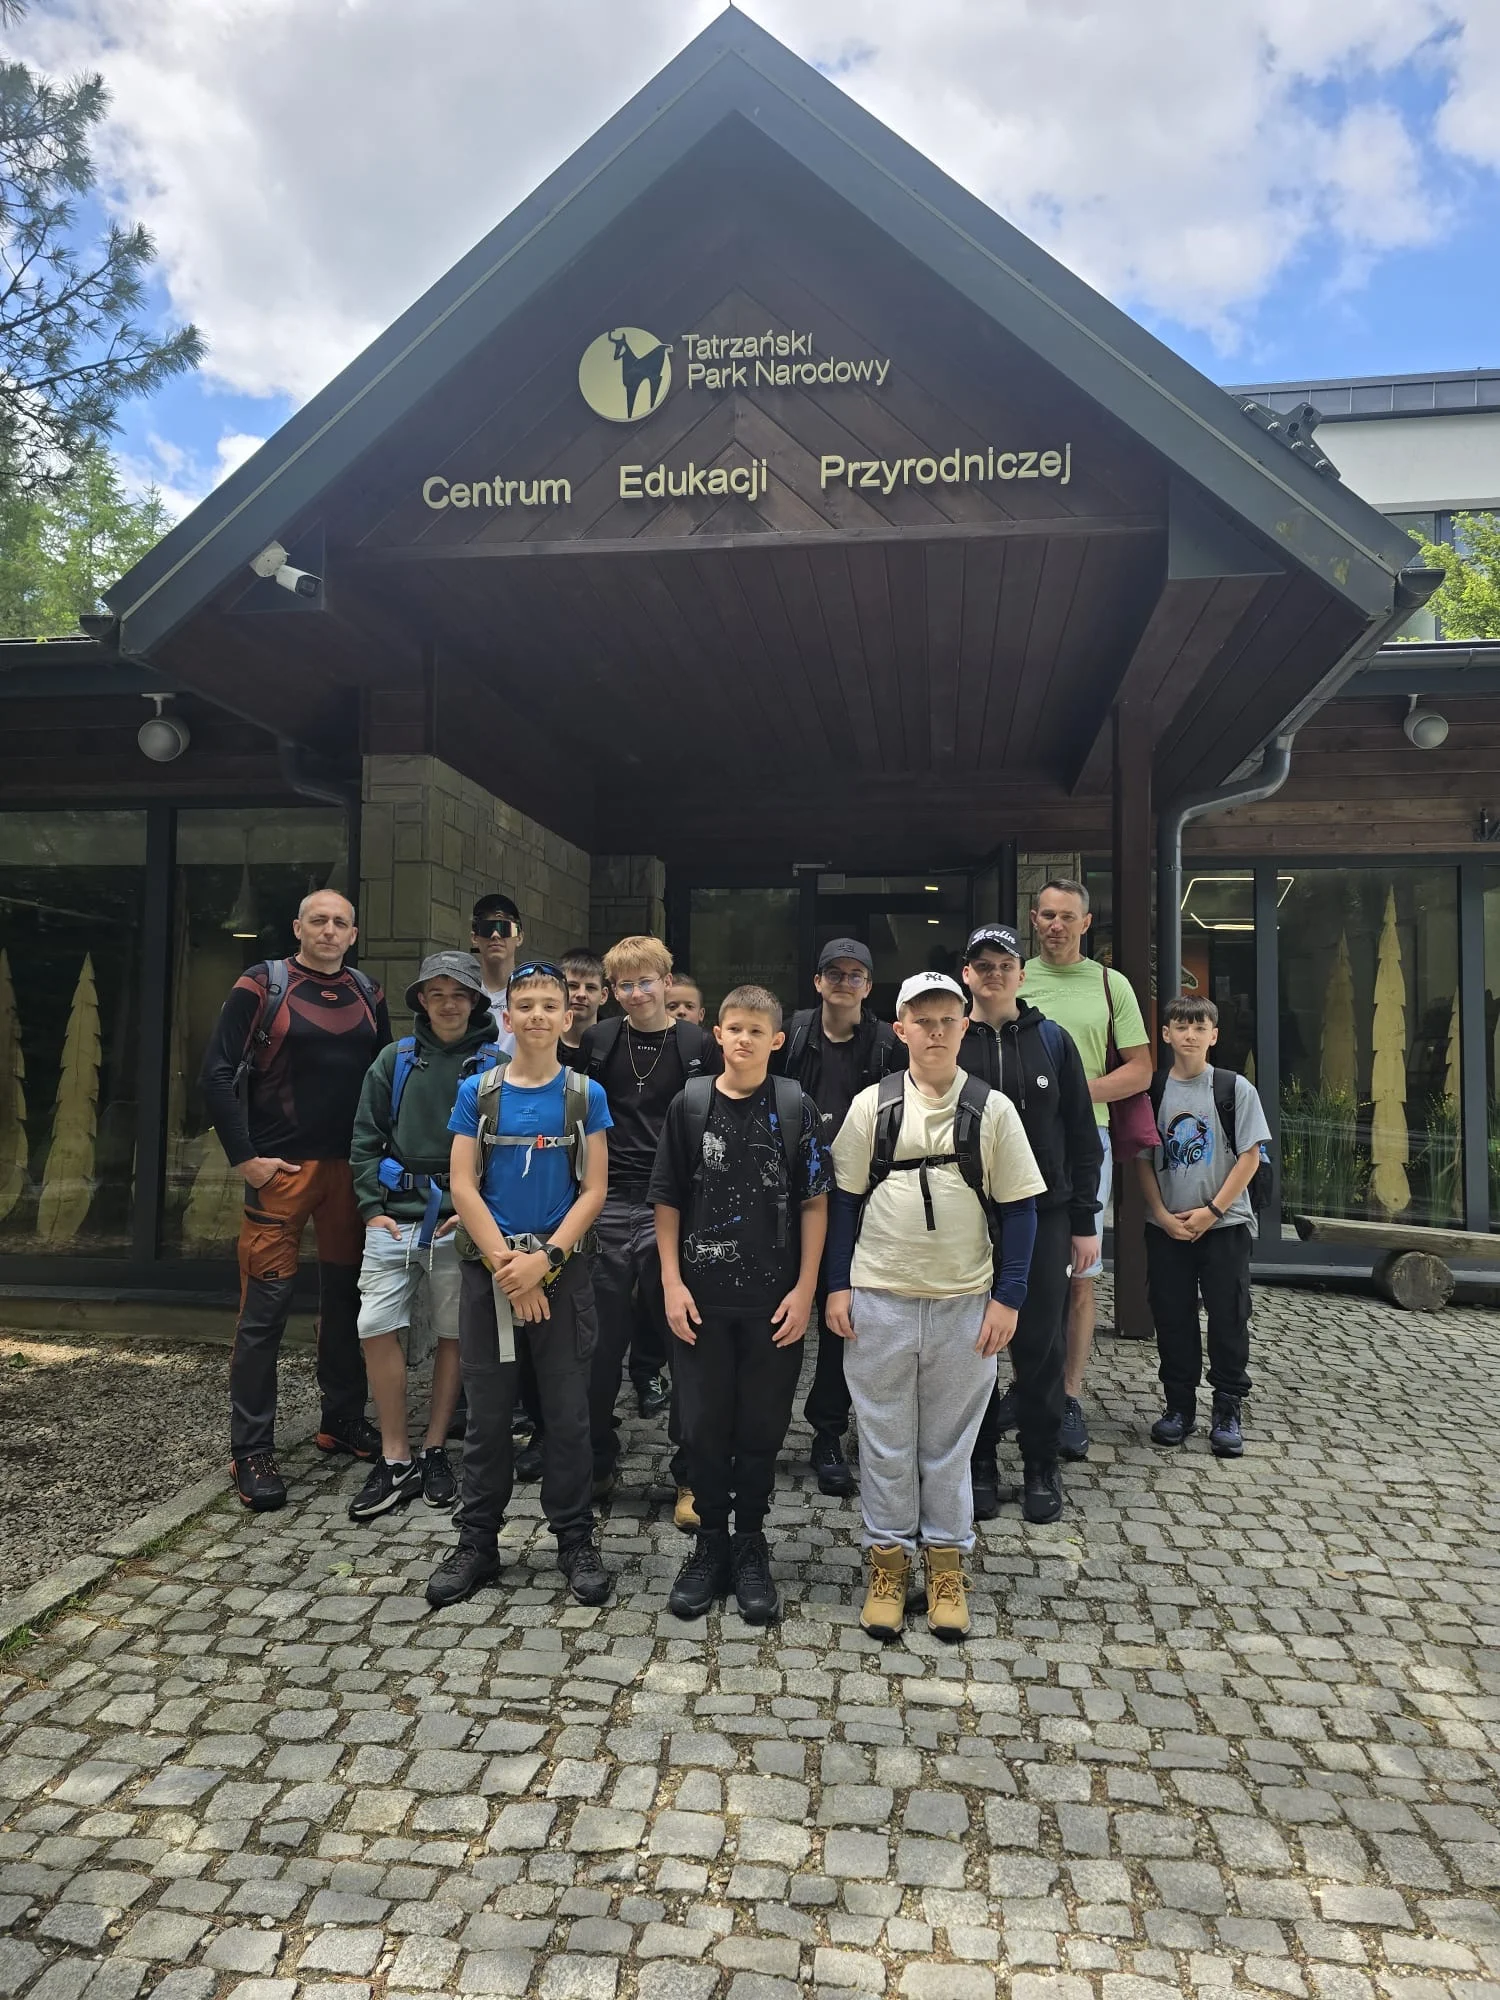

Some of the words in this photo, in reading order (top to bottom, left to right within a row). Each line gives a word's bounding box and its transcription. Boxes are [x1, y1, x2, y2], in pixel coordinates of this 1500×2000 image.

[681, 329, 813, 361] Tatrzański
[687, 361, 749, 390] Park
[755, 356, 891, 387] Narodowy
[422, 475, 572, 510] Centrum
[618, 457, 768, 502] Edukacji
[819, 442, 1071, 496] Przyrodniczej
[972, 929, 1017, 945] Berlin
